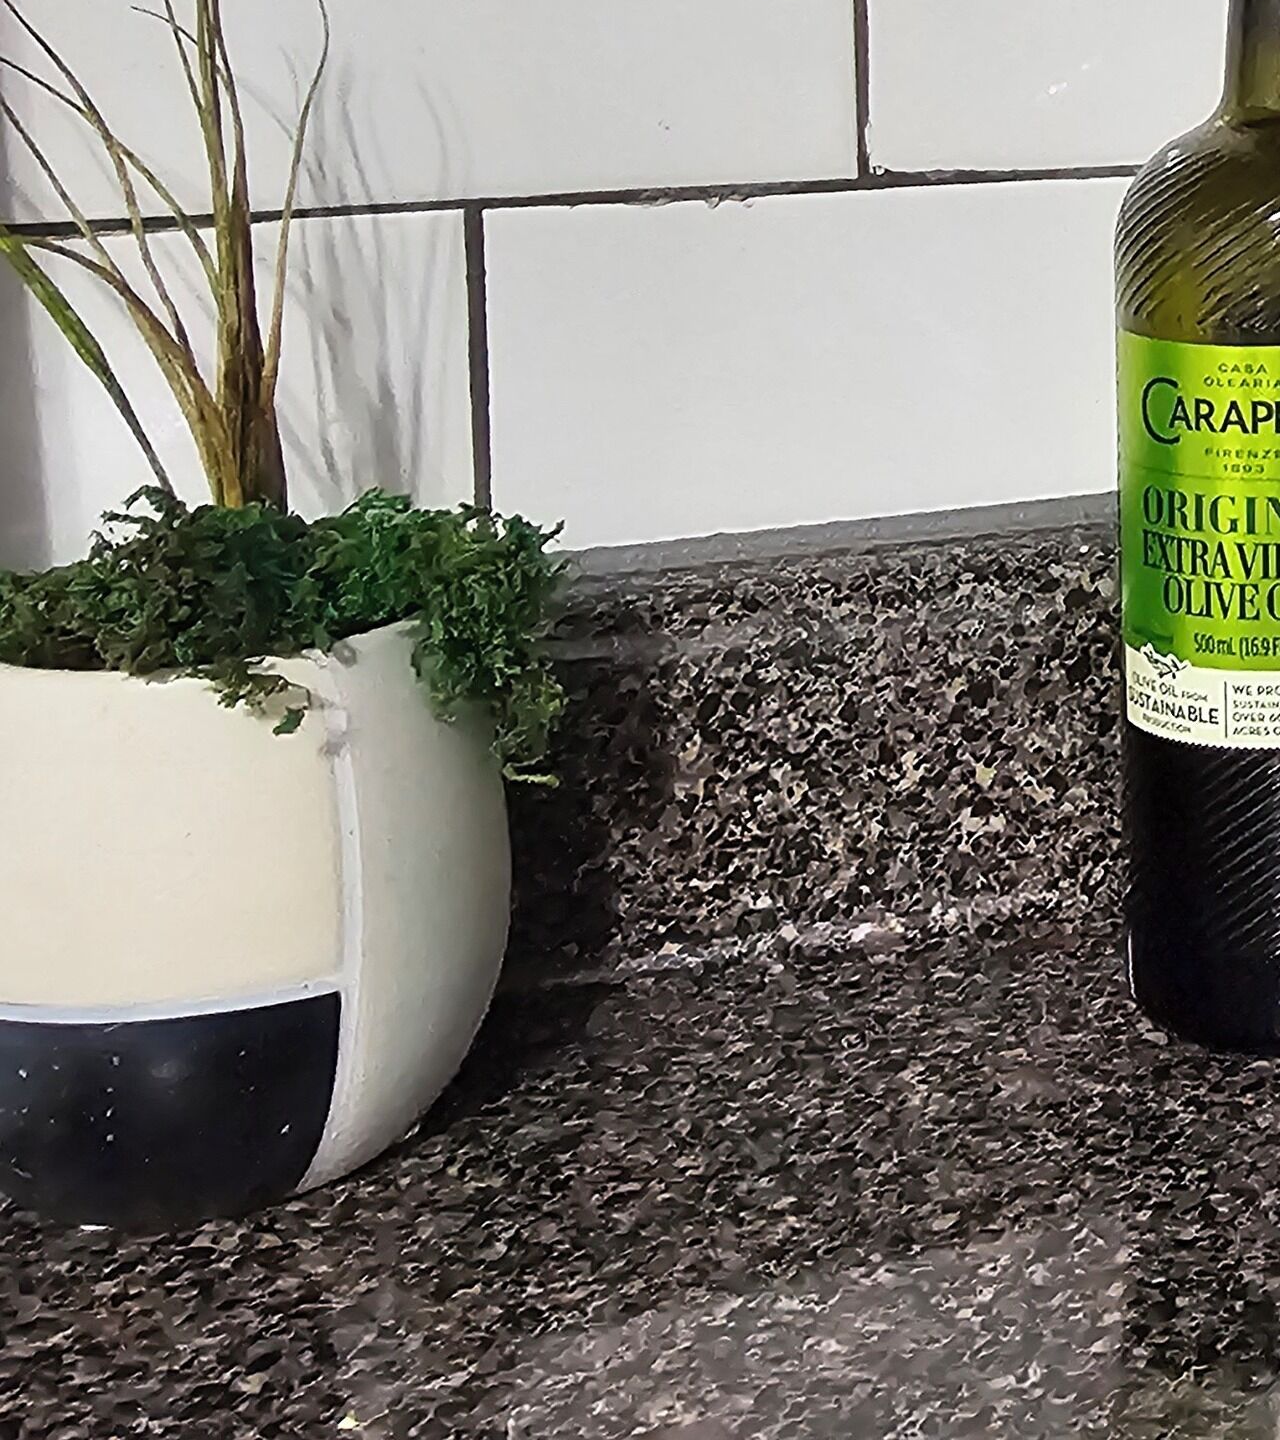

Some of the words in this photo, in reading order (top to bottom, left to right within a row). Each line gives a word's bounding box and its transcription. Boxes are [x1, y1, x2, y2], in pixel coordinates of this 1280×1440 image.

[1217, 362, 1268, 375] CASA
[1222, 463, 1265, 474] 1893
[1142, 528, 1234, 579] EXTRA
[1163, 576, 1261, 621] OLIVE
[1158, 682, 1179, 698] OIL
[1232, 684, 1252, 696] WE
[1232, 711, 1265, 723] OVER
[1232, 726, 1271, 736] ACRES
